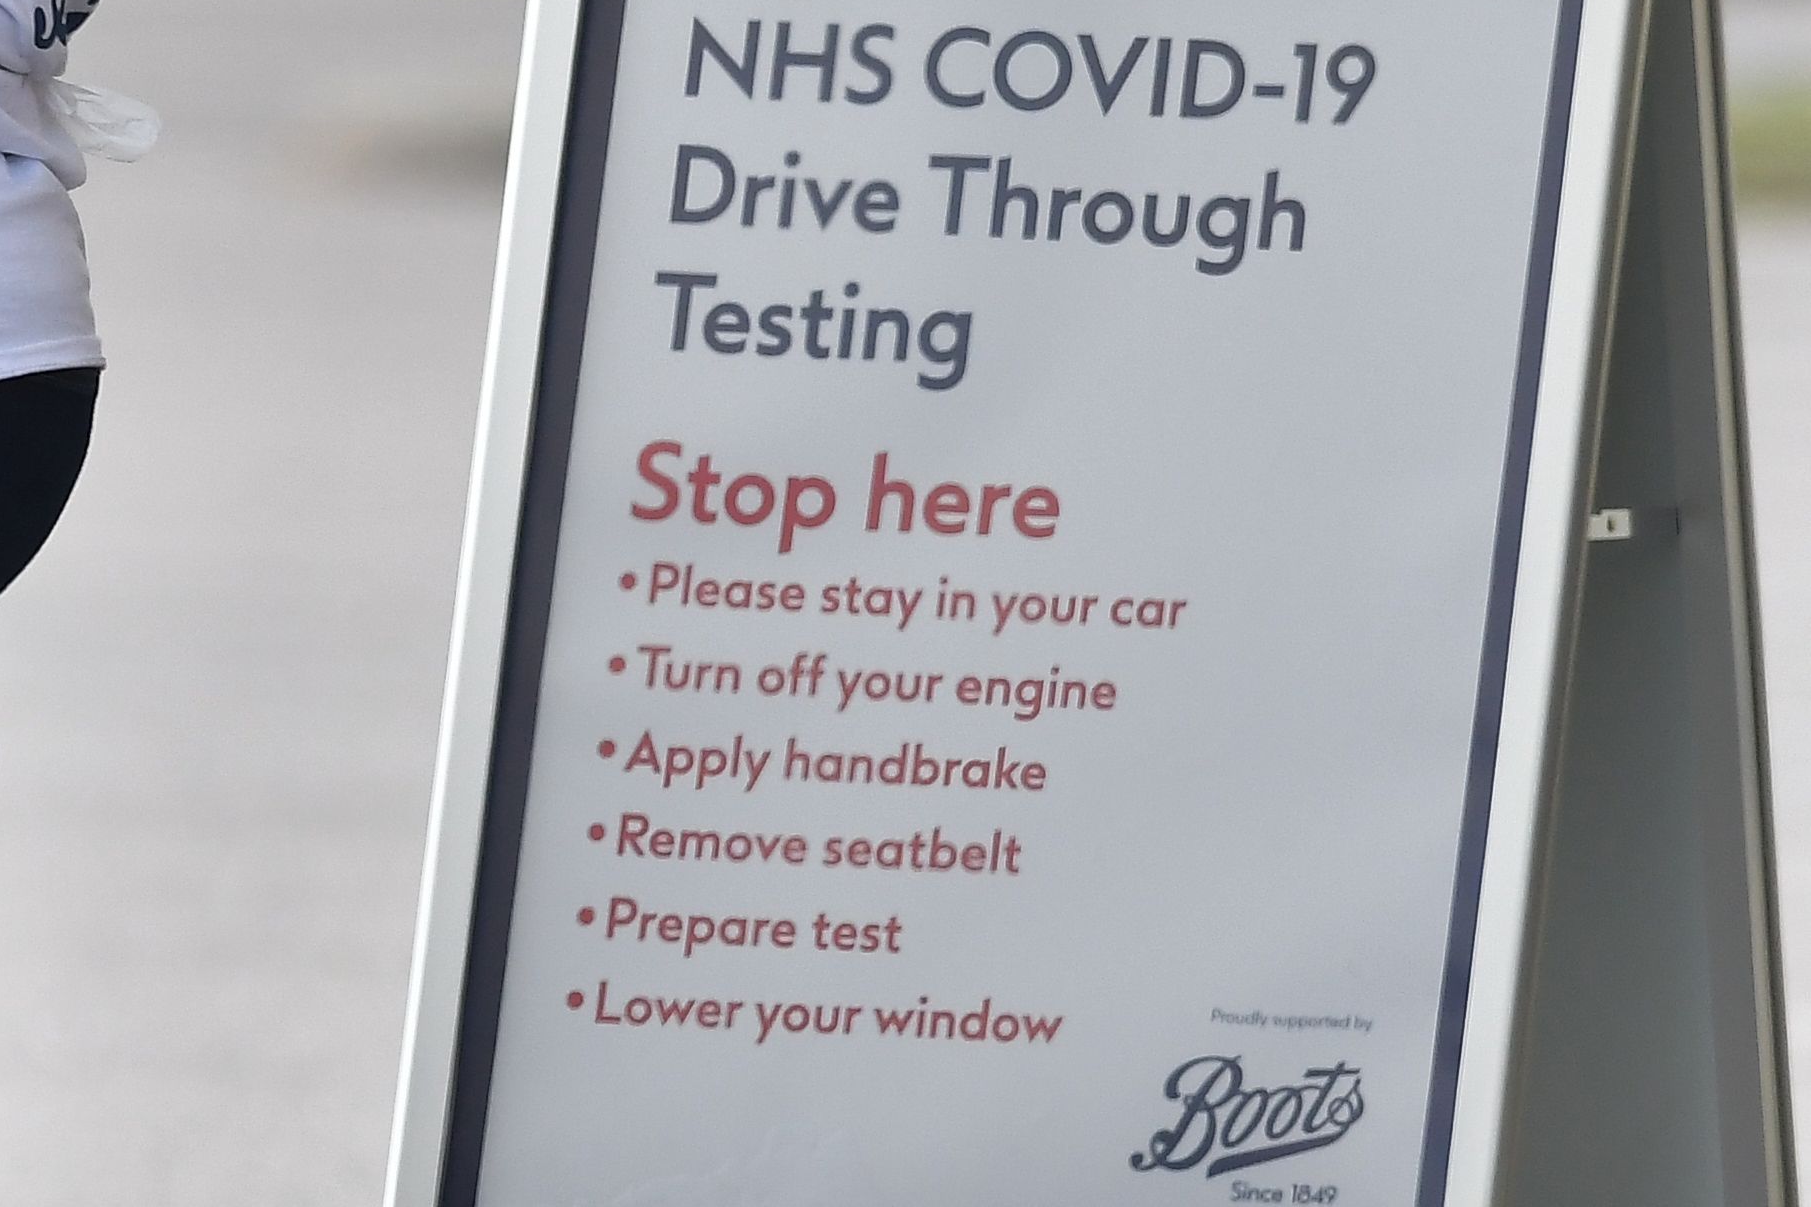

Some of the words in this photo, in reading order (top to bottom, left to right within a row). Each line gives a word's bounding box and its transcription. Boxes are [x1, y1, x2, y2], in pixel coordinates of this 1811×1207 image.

[684, 16, 895, 106] NHS
[924, 26, 1377, 126] COVID-19
[669, 143, 900, 235] Drive
[928, 154, 1306, 276] Through
[654, 271, 973, 392] Testing
[629, 440, 837, 555] Stop
[864, 450, 1061, 539] here
[648, 560, 806, 612] Please
[820, 576, 923, 633] stay
[936, 576, 976, 621] in
[992, 593, 1099, 637] your
[1110, 598, 1188, 630] car
[637, 644, 741, 695] Turn
[757, 653, 828, 697] off
[837, 670, 944, 713] your
[955, 666, 1117, 722] engine
[623, 730, 772, 793] Apply
[784, 736, 1047, 792] handbrake
[616, 812, 808, 865] Remove
[822, 825, 1022, 875] seatbelt
[605, 896, 797, 959] Prepare
[812, 913, 903, 954] test
[594, 980, 744, 1029] Lower
[755, 1002, 863, 1045] your
[873, 996, 1063, 1044] window
[1210, 1007, 1270, 1029] Proudly
[1353, 1015, 1373, 1033] by
[1128, 1054, 1365, 1178] Boots
[1230, 1180, 1284, 1204] Since
[1291, 1183, 1338, 1205] 1849
